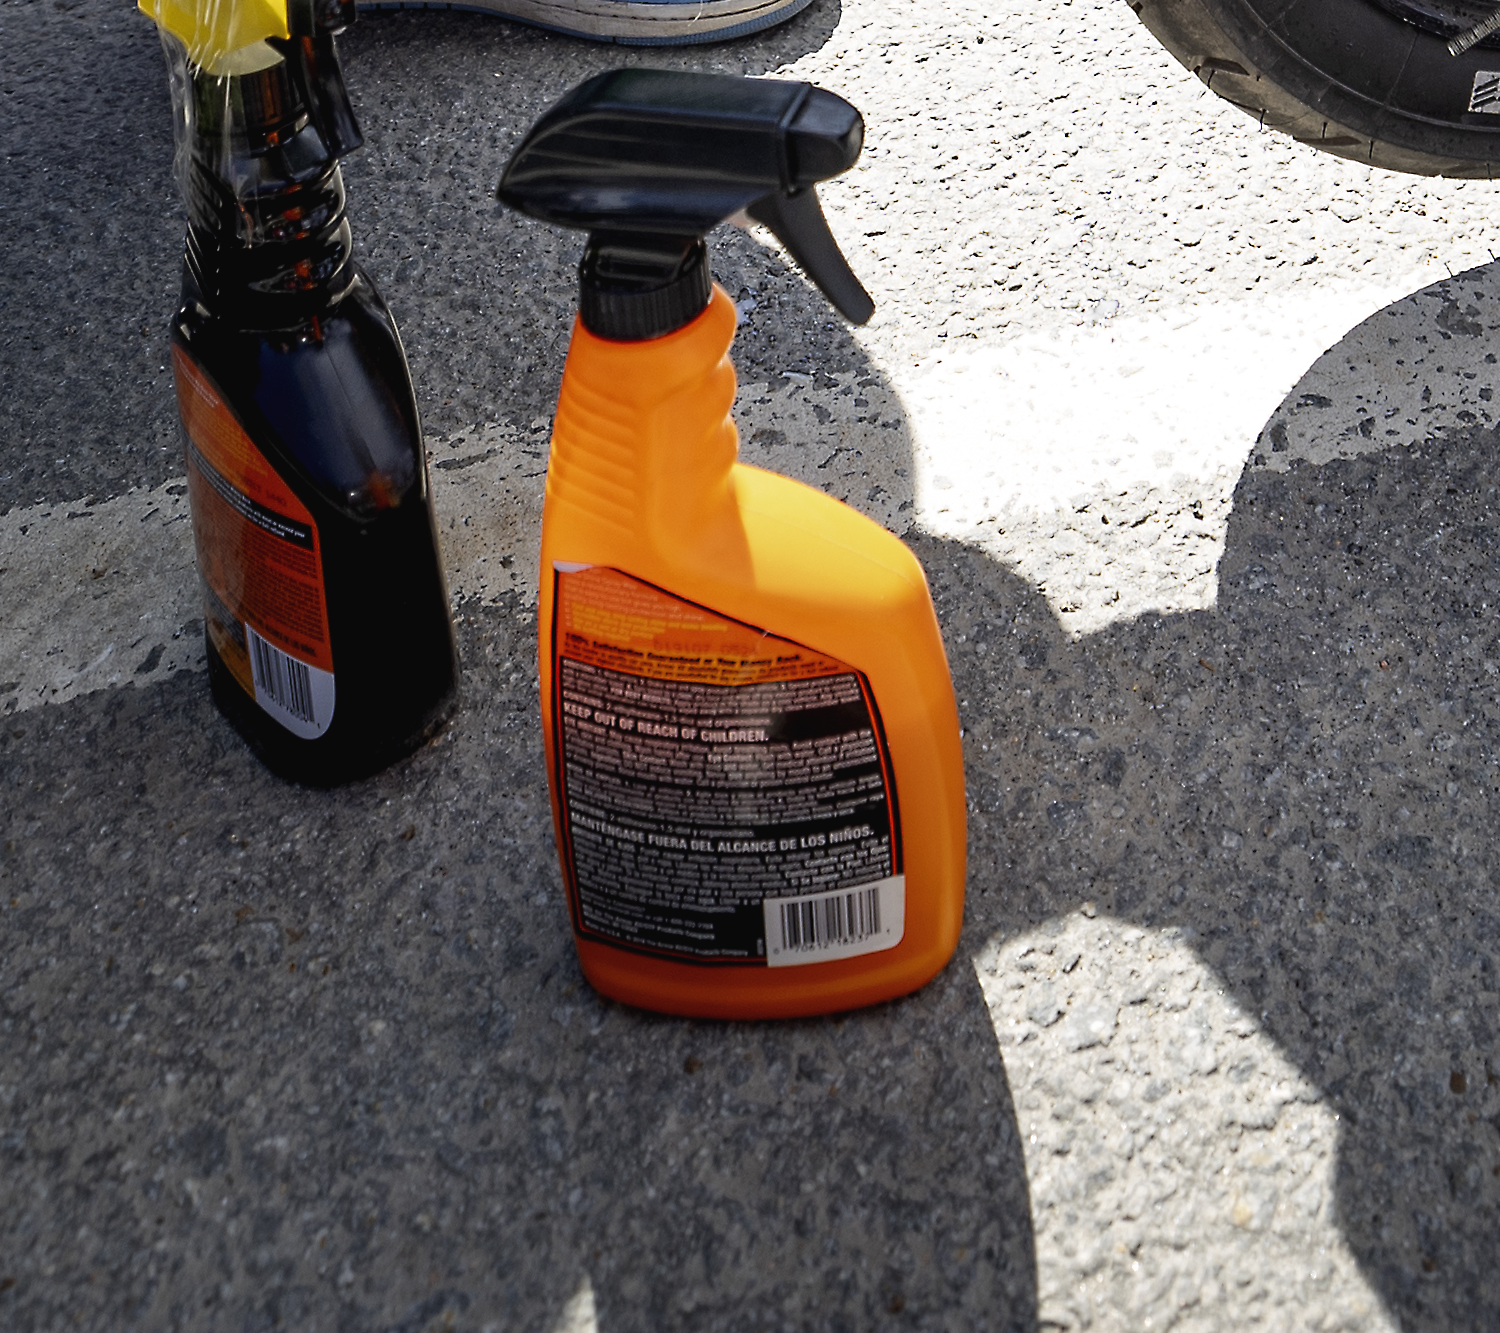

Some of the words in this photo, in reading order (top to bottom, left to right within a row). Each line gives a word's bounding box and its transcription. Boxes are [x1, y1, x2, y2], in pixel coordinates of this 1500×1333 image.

[563, 702, 591, 720] KEEP
[594, 711, 617, 728] OUT
[619, 718, 635, 731] OF
[637, 722, 679, 739] REACH
[681, 728, 698, 741] OF
[700, 728, 770, 743] CHILDREN.
[570, 811, 646, 844] MANTÉNGASE
[648, 834, 688, 851] FUERA
[690, 840, 715, 853] DEL
[717, 840, 777, 854] ALCANCE
[780, 838, 798, 851] DE
[800, 834, 827, 849] LOS
[829, 824, 875, 844] NIÑOS.
